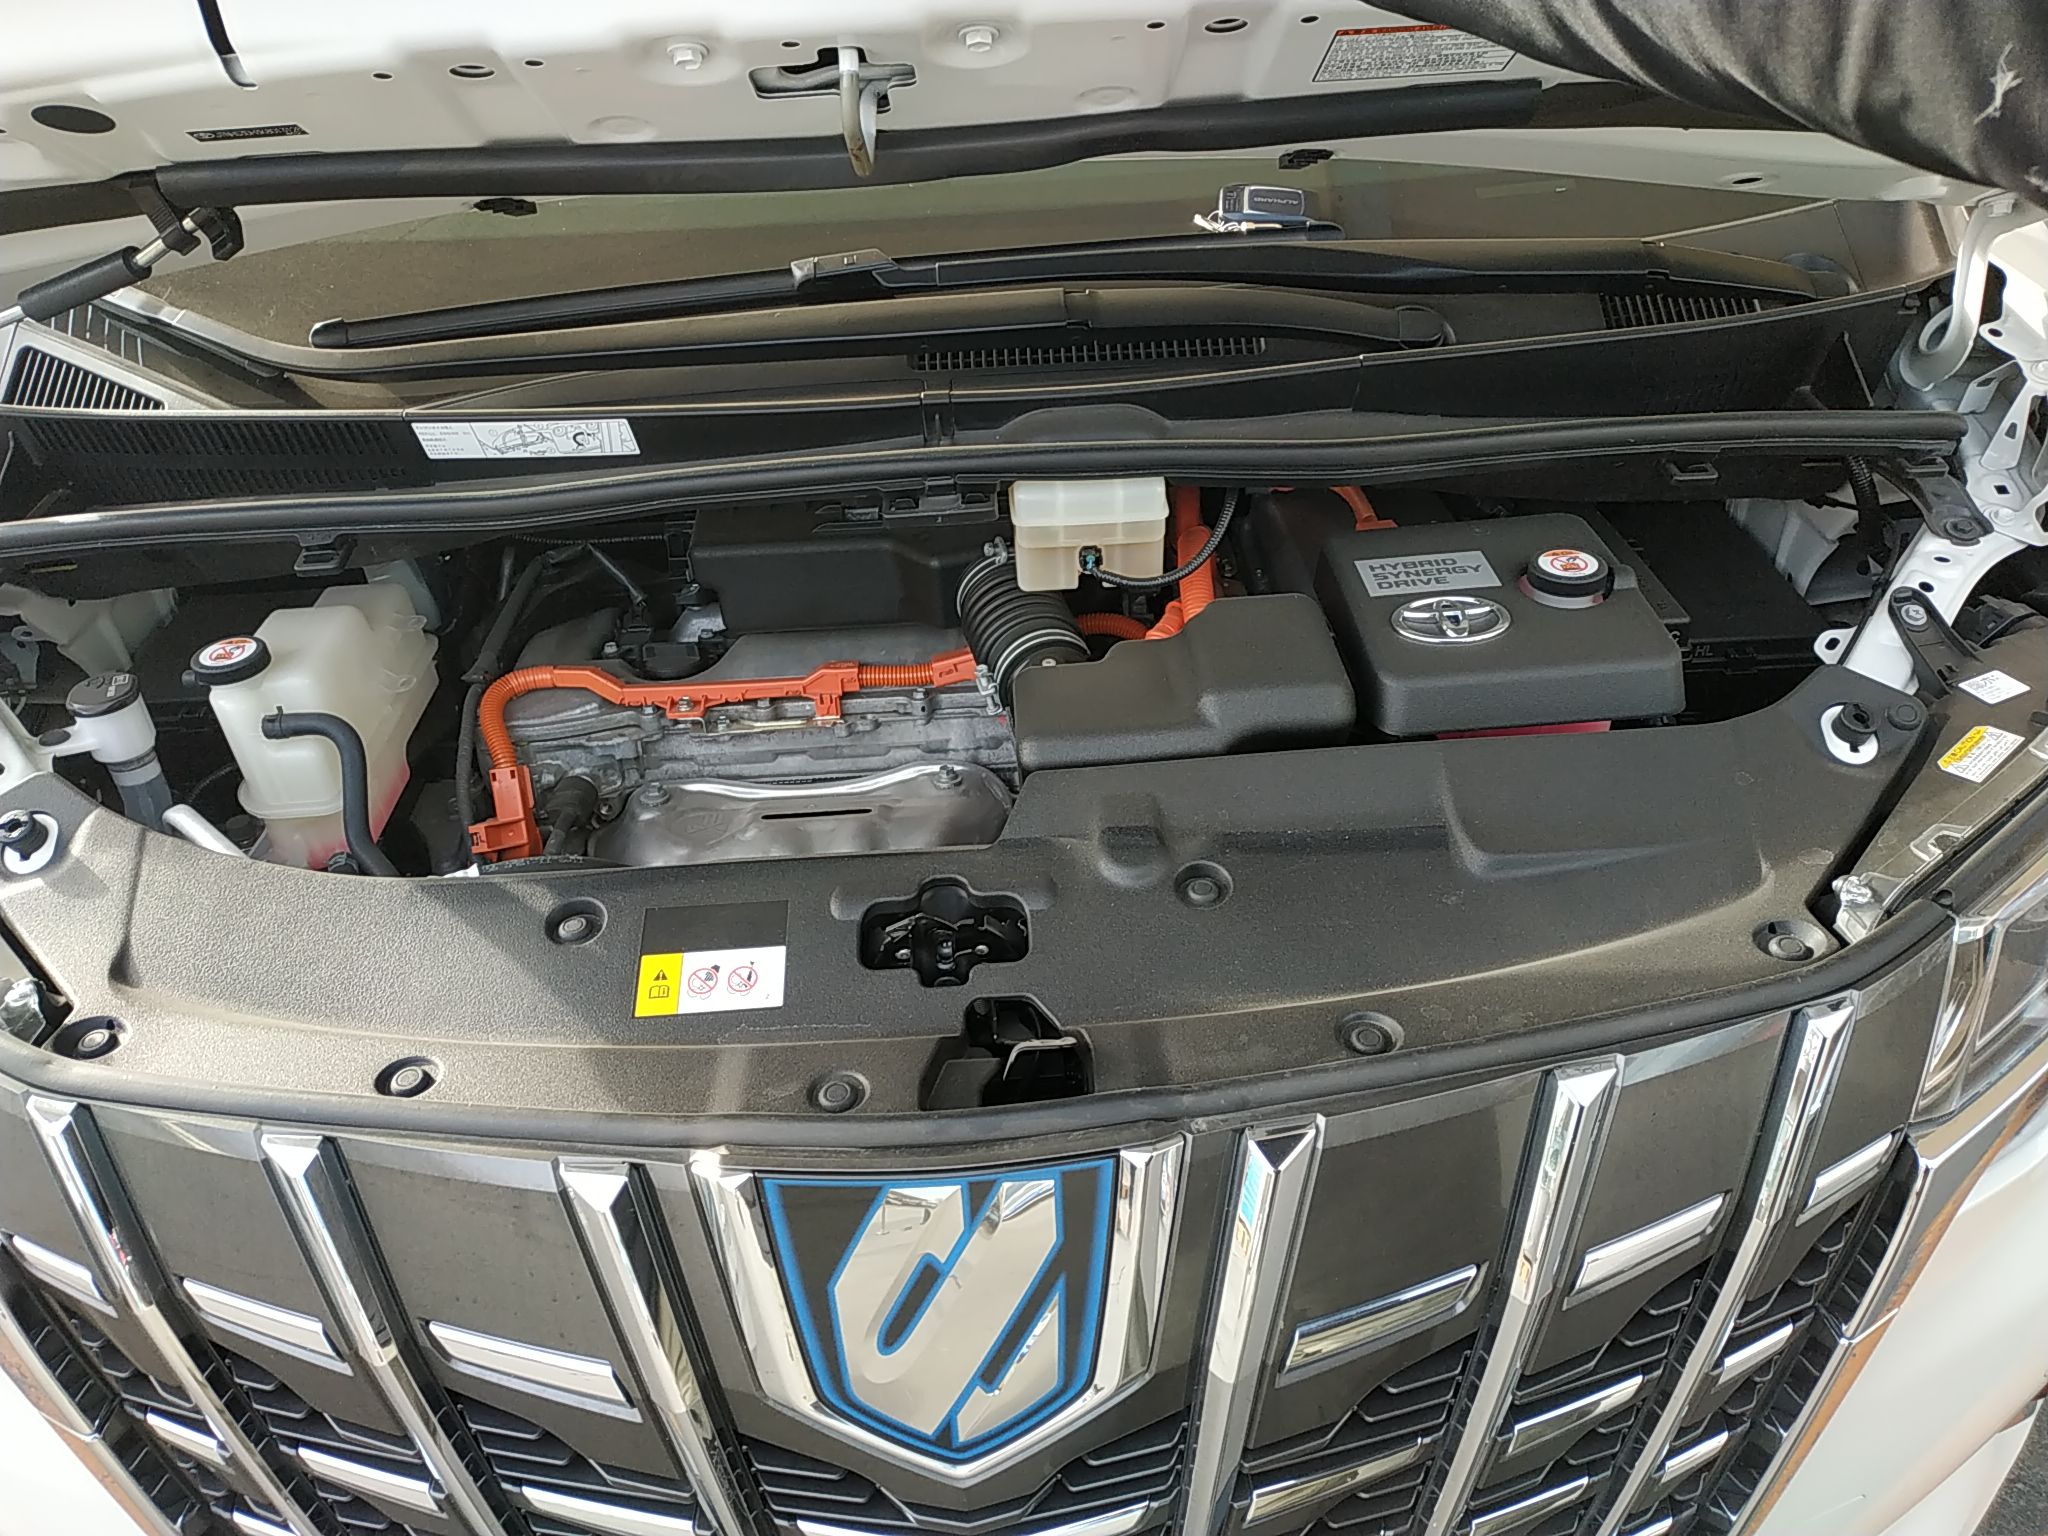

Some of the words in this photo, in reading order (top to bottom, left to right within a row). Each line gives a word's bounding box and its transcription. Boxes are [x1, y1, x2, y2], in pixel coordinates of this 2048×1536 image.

[1369, 558, 1458, 572] HYBRID
[1372, 564, 1482, 581] SYNERGY
[1376, 576, 1450, 590] DRIVE
